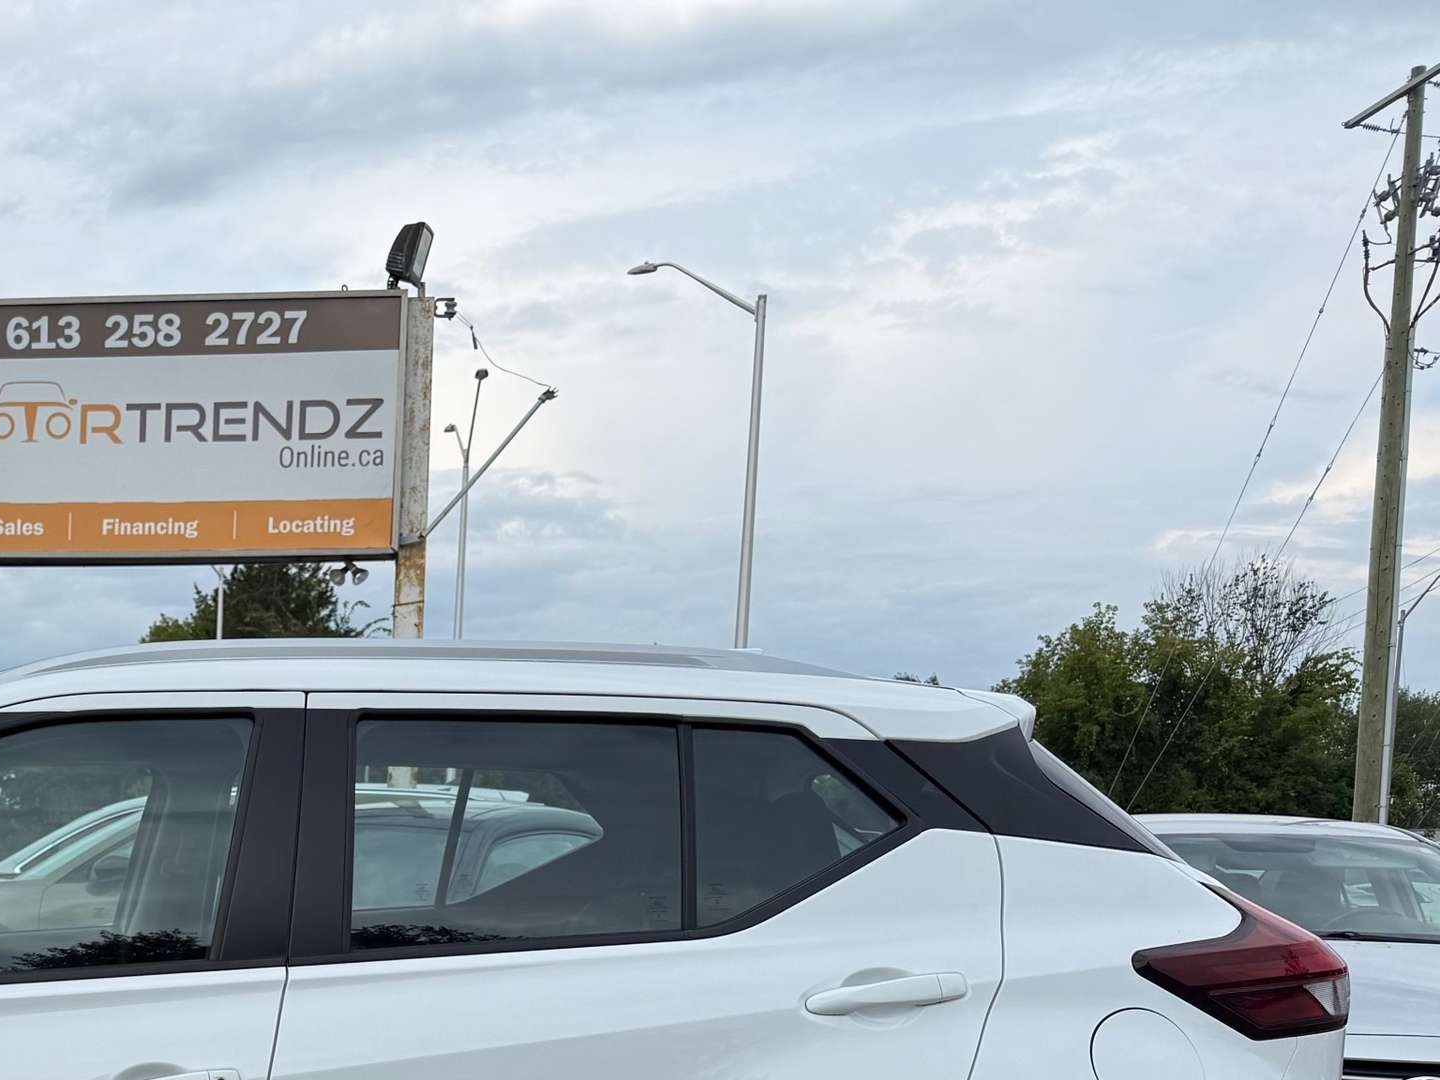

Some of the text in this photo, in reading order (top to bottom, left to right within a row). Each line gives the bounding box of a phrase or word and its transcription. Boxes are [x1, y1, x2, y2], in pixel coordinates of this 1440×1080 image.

[6, 310, 307, 350] 613 258 2727
[279, 444, 384, 468] Online.ca
[101, 517, 199, 538] Financing
[268, 515, 355, 536] Locating
